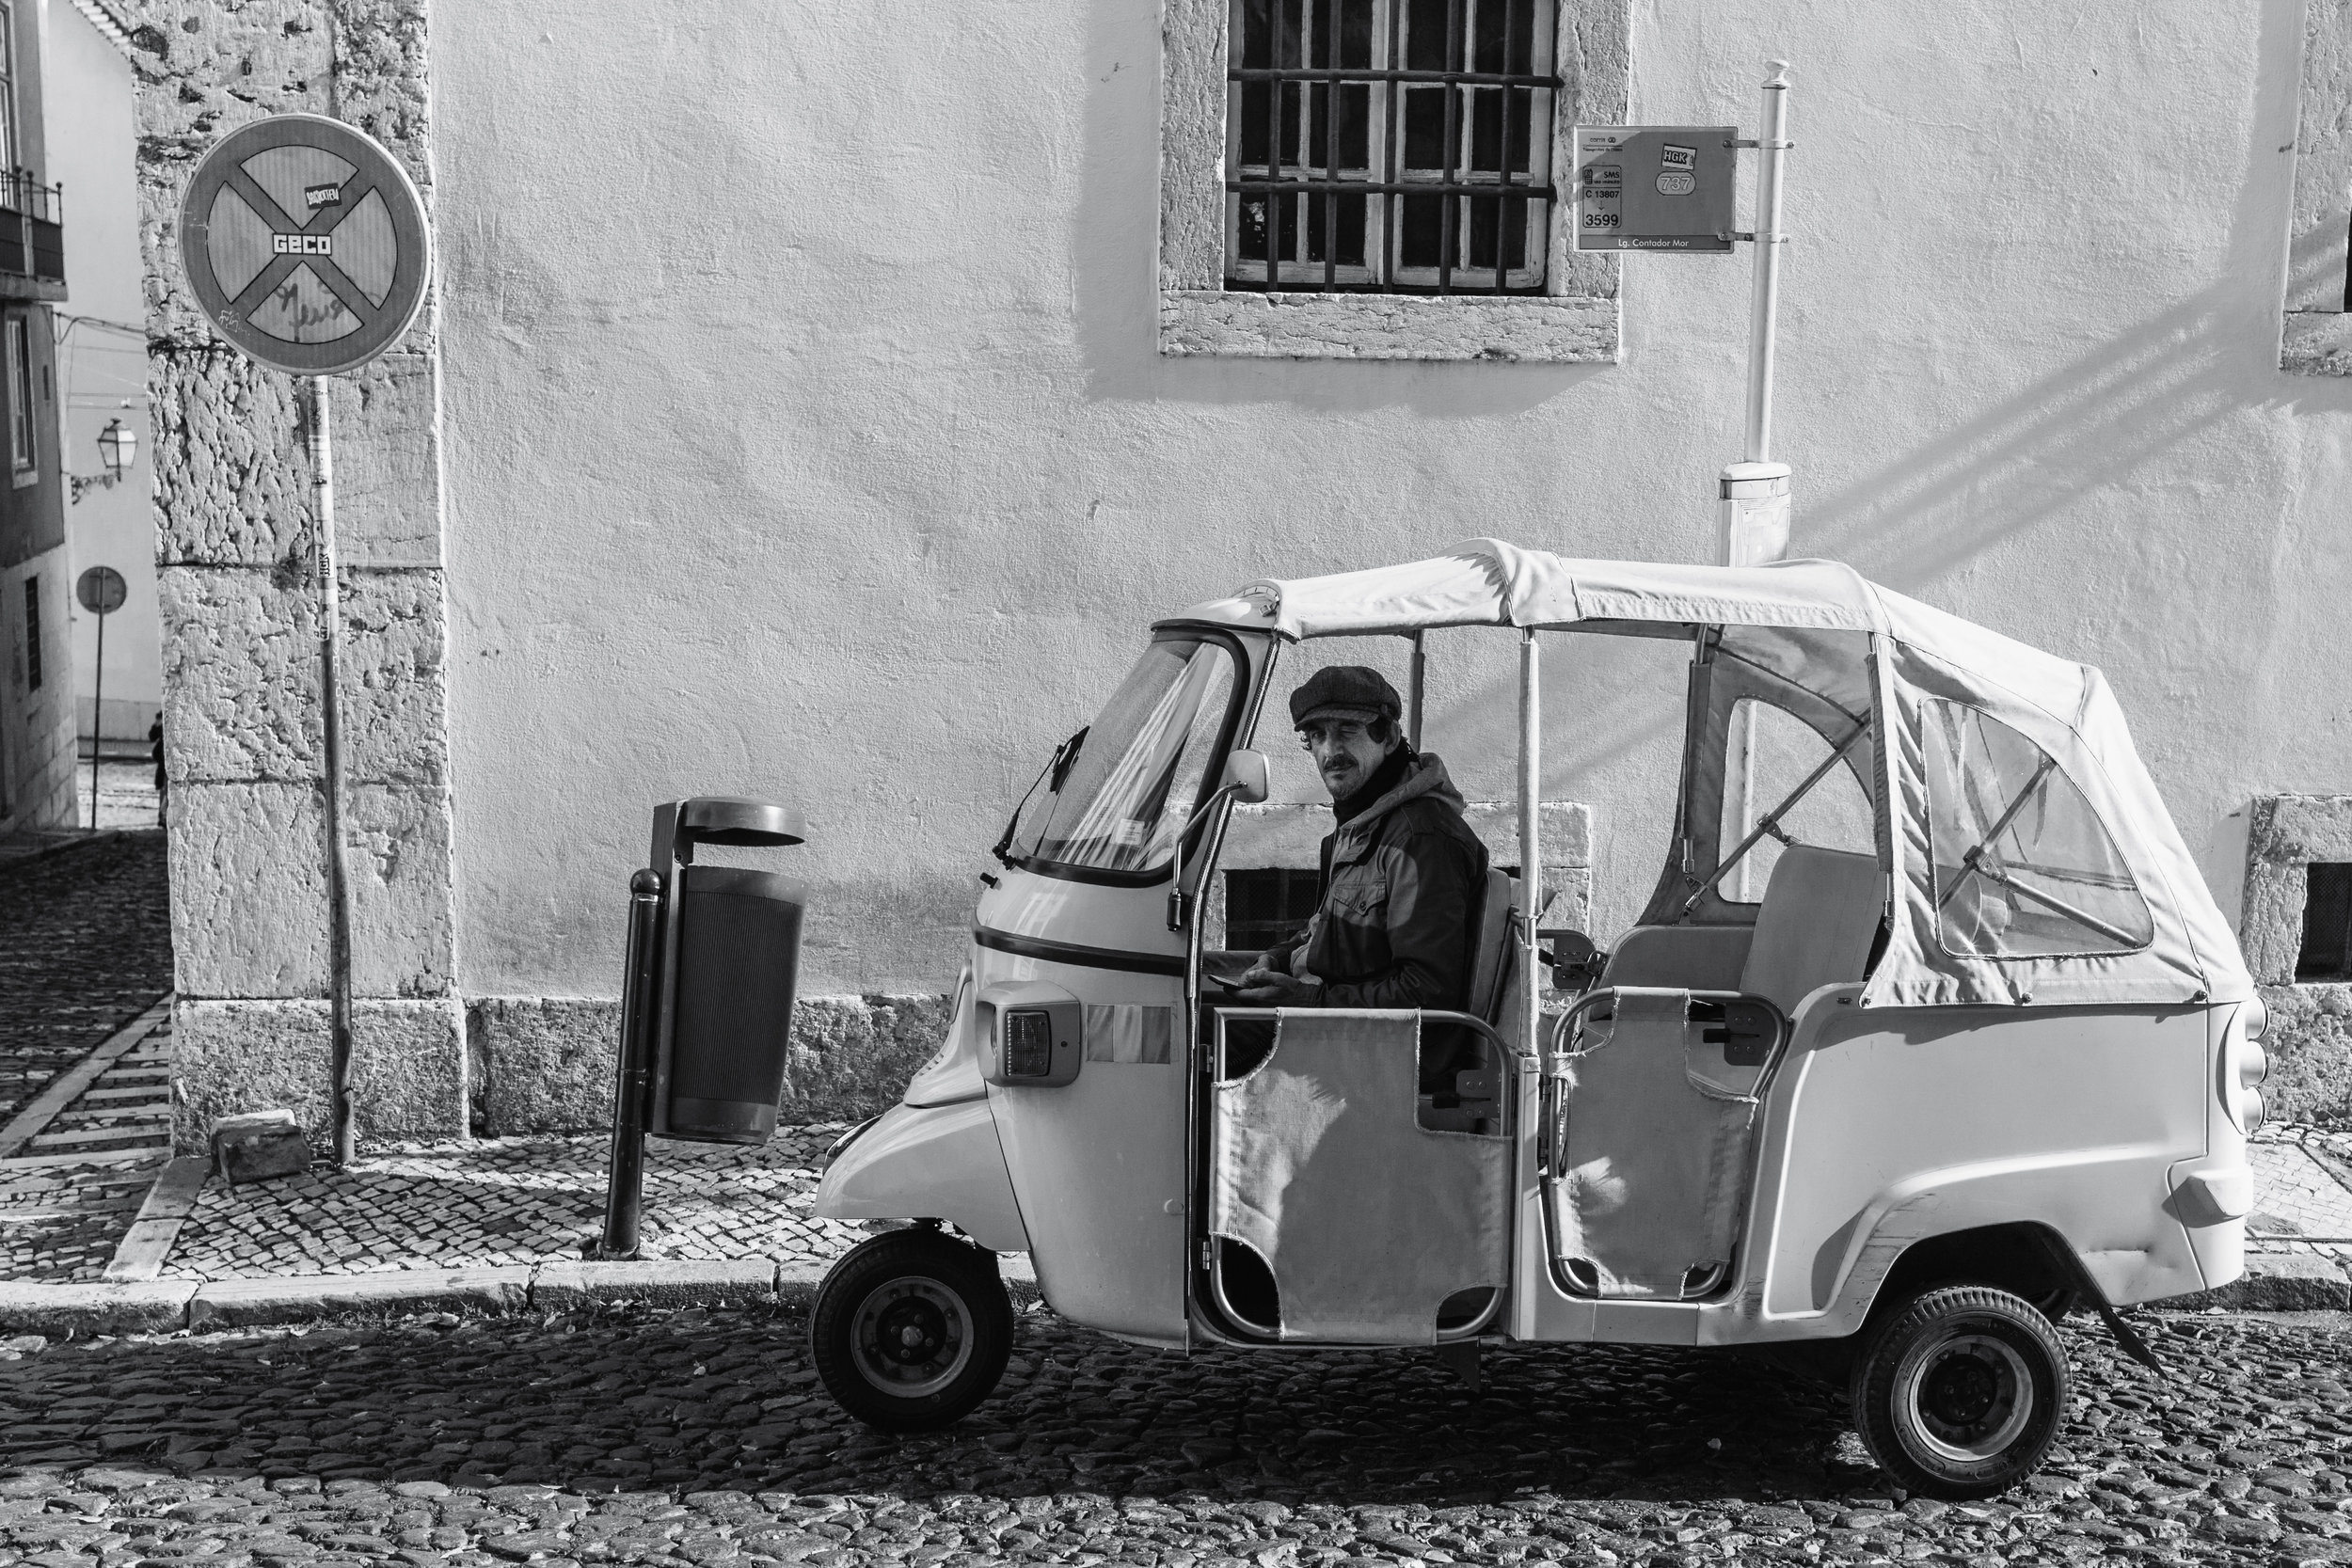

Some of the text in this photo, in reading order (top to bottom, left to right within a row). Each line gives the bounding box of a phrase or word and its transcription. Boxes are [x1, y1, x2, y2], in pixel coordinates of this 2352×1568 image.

[1663, 150, 1687, 165] HGK
[1661, 176, 1692, 190] 737
[1585, 189, 1620, 198] C 13807
[1585, 214, 1619, 226] 3599
[1618, 238, 1690, 248] Lg. Contador Mor
